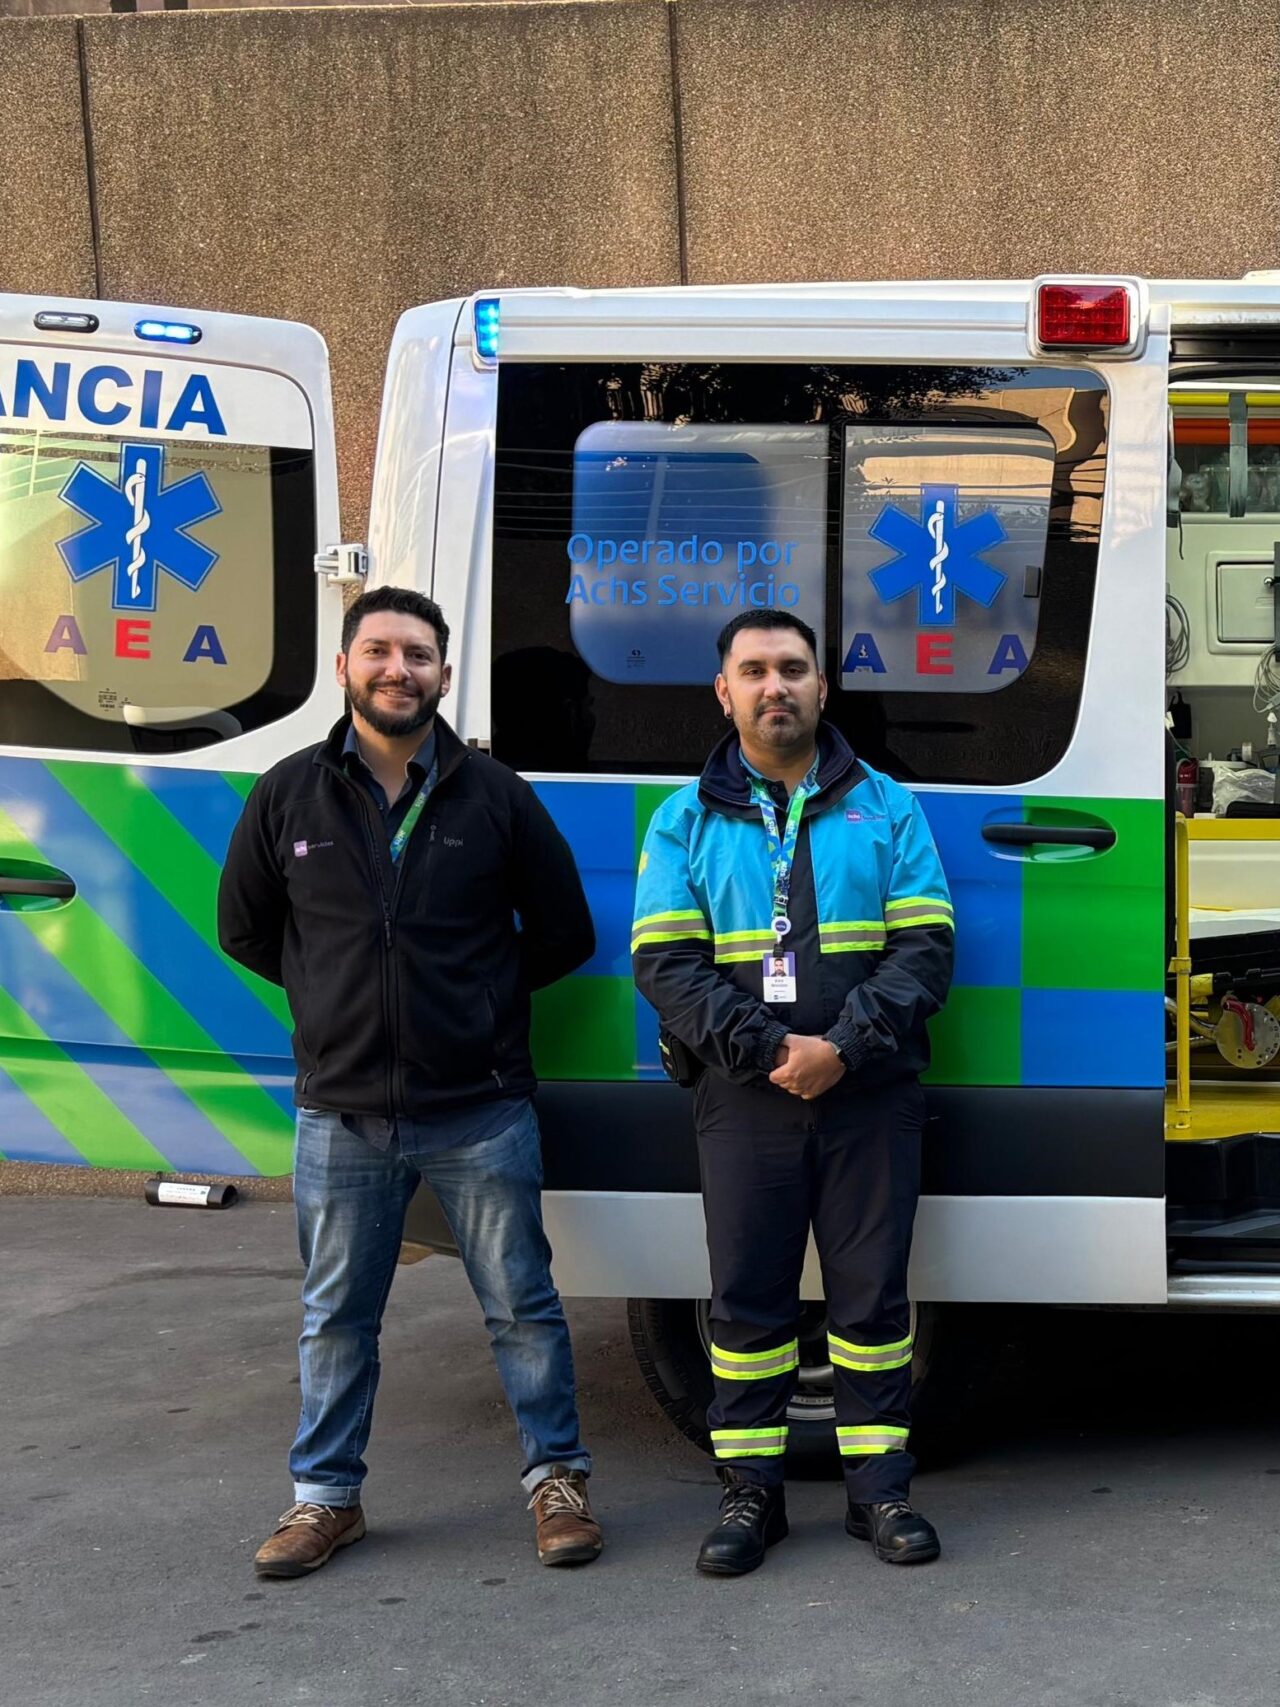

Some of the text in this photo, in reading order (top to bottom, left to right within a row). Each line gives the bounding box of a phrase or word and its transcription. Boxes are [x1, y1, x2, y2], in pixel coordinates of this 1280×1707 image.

[0, 359, 227, 435] NCIA
[567, 534, 797, 572] Operado por
[565, 573, 800, 607] Achs Servicio
